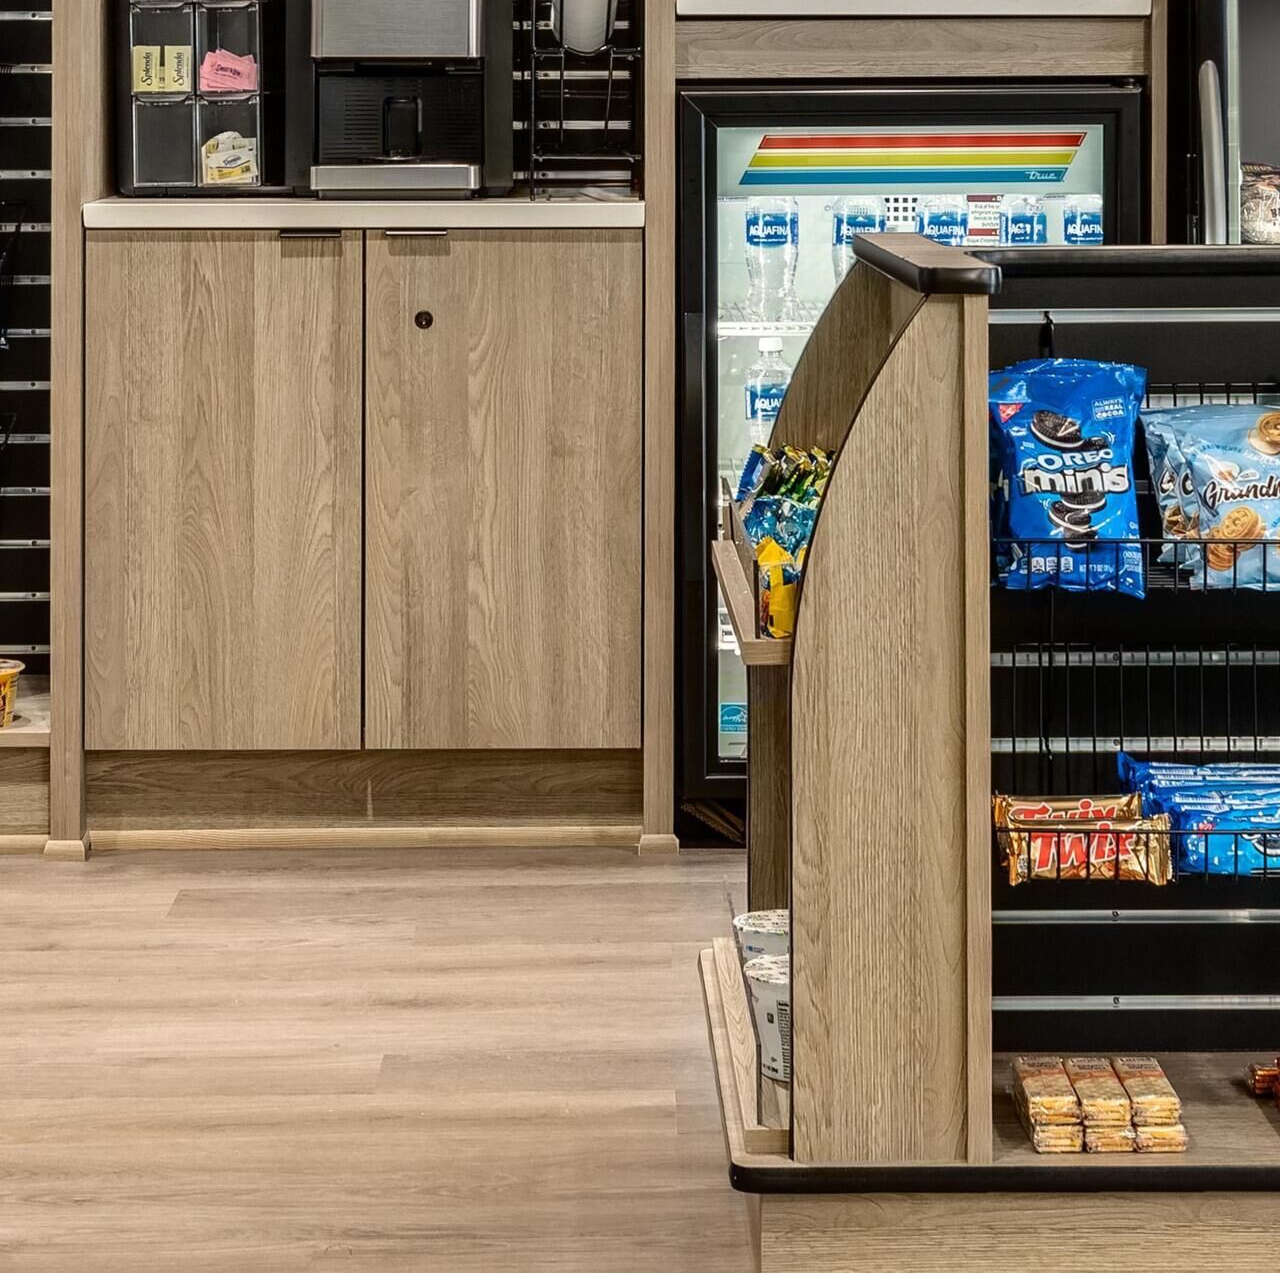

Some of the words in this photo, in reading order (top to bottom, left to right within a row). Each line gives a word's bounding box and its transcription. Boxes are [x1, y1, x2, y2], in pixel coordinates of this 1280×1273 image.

[141, 51, 153, 86] Splenda
[173, 51, 185, 86] Splenda
[749, 225, 790, 237] AQUAFINA
[923, 224, 966, 237] AQUAFINA
[1094, 399, 1124, 407] ALWAYS
[1095, 410, 1124, 418] COCOA
[1036, 448, 1114, 471] OREO
[1023, 463, 1130, 495] minis
